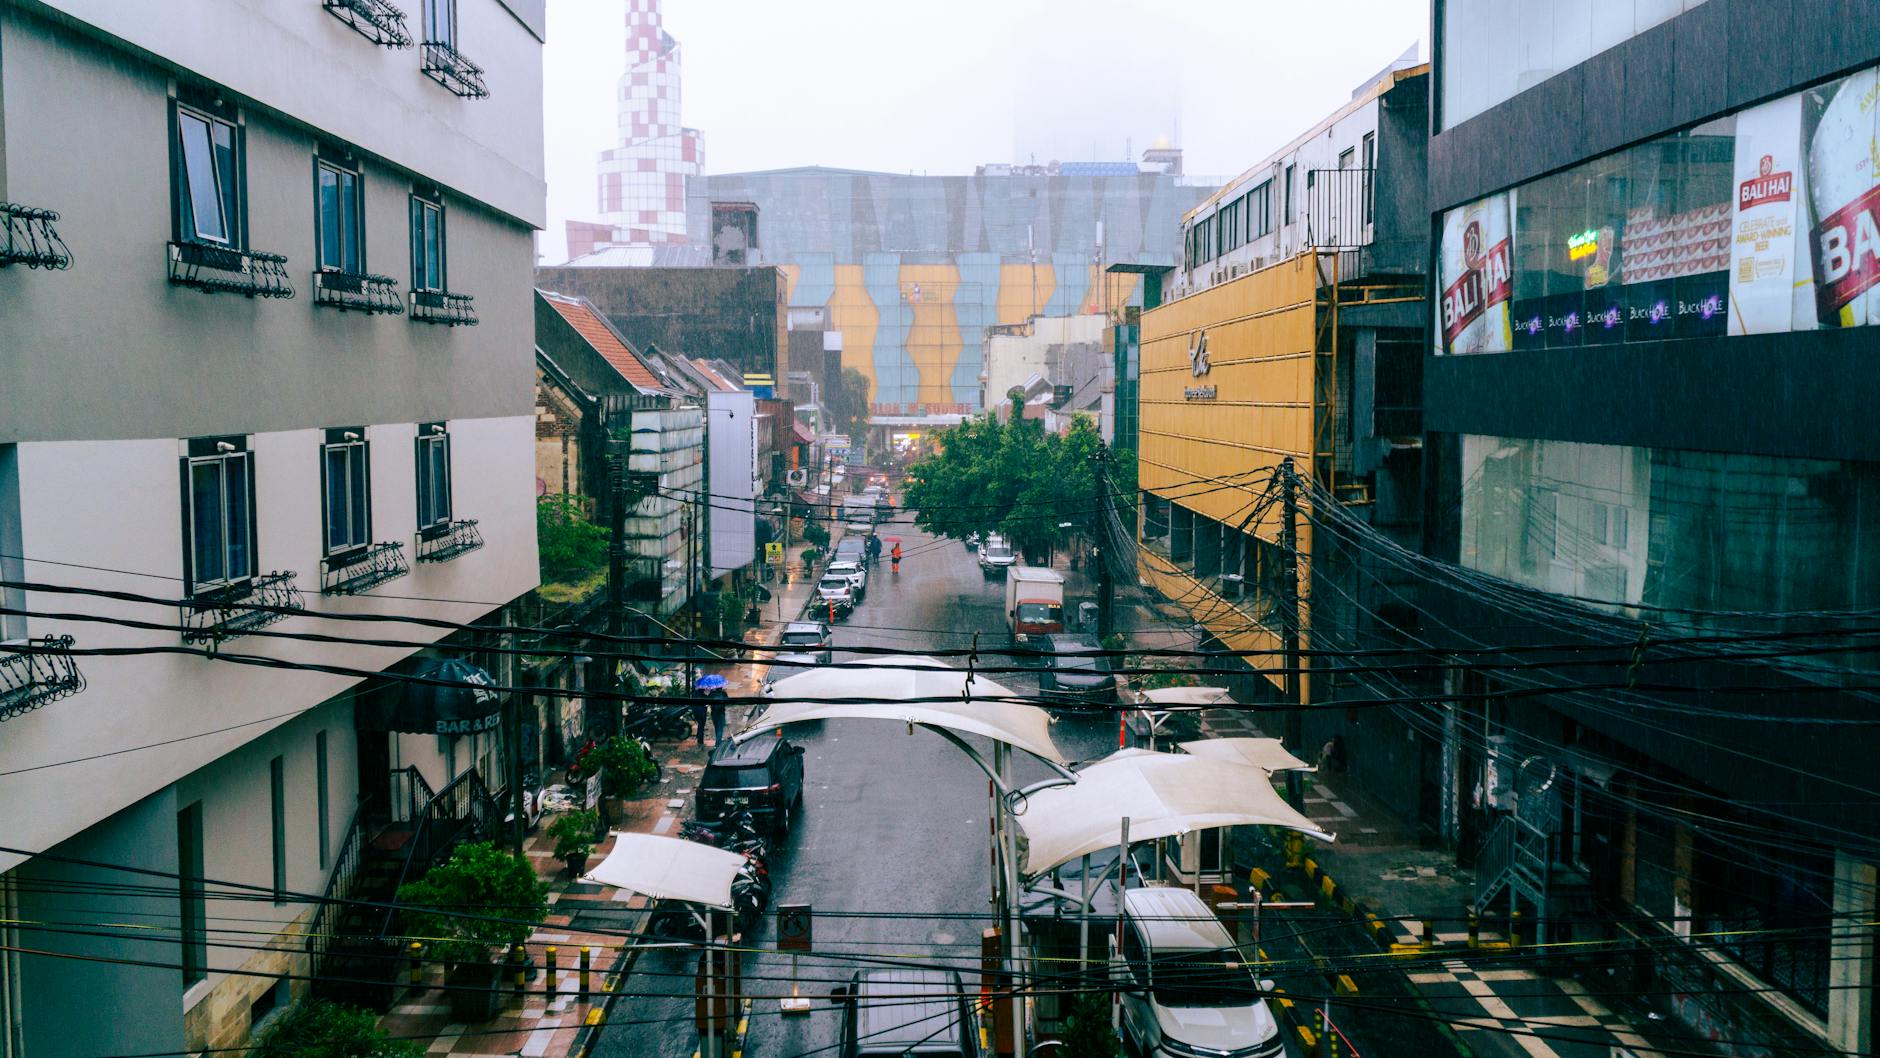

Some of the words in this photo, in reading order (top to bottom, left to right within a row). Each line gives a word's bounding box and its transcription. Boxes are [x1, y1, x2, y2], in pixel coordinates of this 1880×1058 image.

[1742, 182, 1767, 202] BALI
[1768, 176, 1790, 197] HAI
[1443, 274, 1479, 330] BALI
[1480, 244, 1511, 299] HAI
[436, 719, 471, 733] BAR
[474, 718, 484, 731] &
